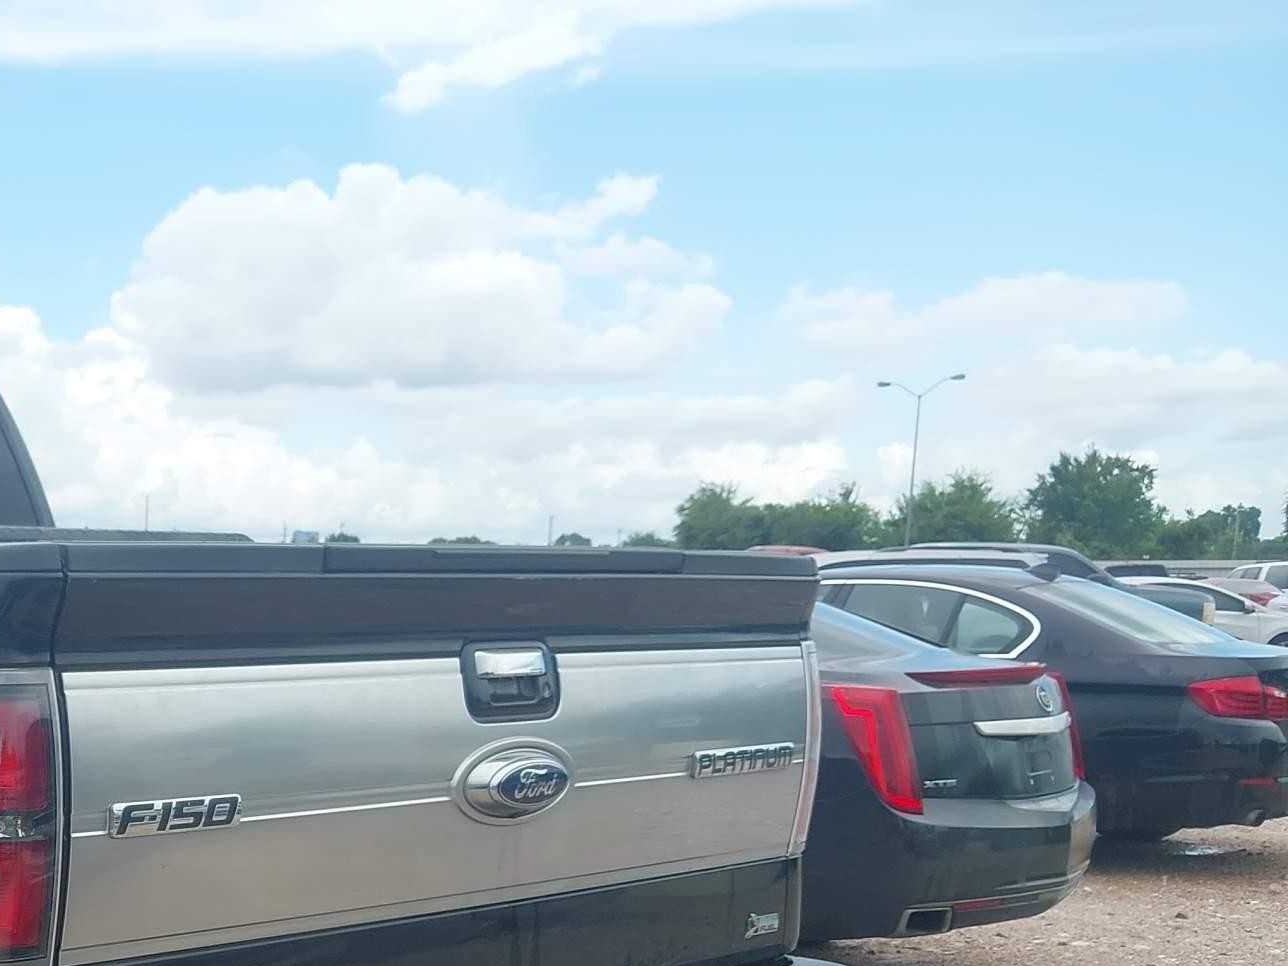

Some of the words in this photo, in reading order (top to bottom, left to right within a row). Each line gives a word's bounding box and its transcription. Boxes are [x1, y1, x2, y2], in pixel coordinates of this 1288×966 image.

[697, 744, 793, 777] PLATINUM
[514, 768, 558, 799] Ford
[113, 795, 241, 837] F-150
